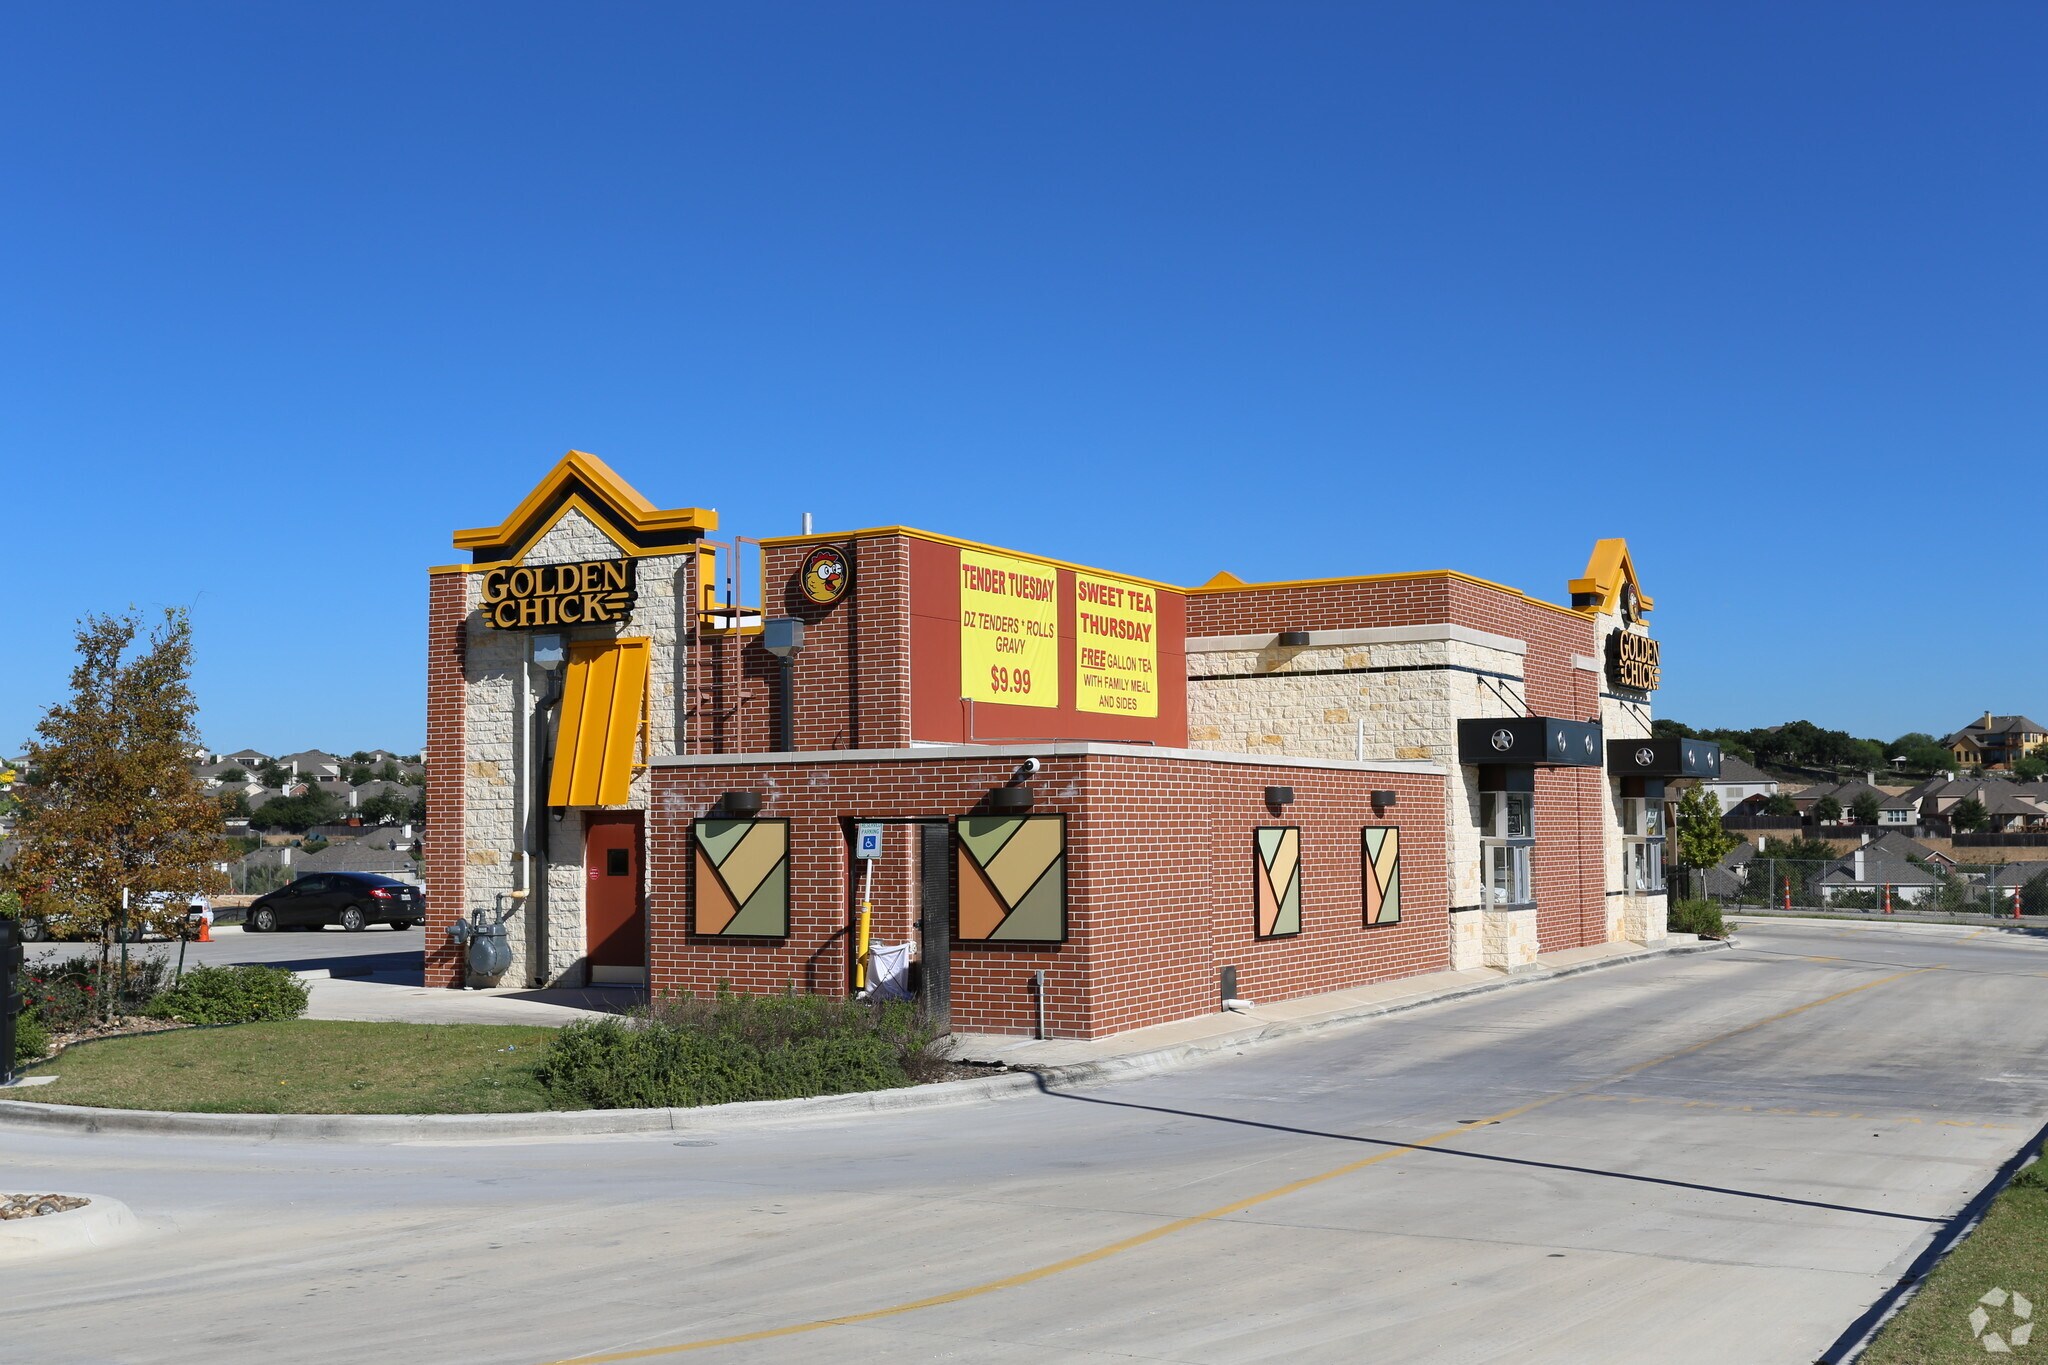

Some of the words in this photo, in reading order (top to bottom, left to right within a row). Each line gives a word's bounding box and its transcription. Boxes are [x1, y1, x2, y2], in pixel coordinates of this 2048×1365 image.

[481, 560, 628, 604] GOLDEN
[962, 564, 1006, 596] TENDER
[1008, 573, 1055, 603] TUESDAY
[1078, 580, 1124, 608] SWEET
[1127, 591, 1153, 613] TEA
[494, 592, 611, 628] CHICK
[964, 610, 976, 629] DZ
[978, 612, 1019, 634] TENDERS
[1026, 620, 1054, 639] ROLLS
[1080, 612, 1152, 643] THURSDAY
[995, 635, 1026, 655] GRAVY
[1081, 647, 1106, 670] FREE
[1107, 653, 1137, 672] GALLON
[1138, 657, 1152, 674] TEA
[1620, 630, 1660, 667] GOLDEN
[991, 664, 1031, 694] $9.99
[1083, 674, 1103, 688] WITH
[1104, 676, 1129, 692] FAMILY
[1131, 679, 1151, 694] MEAL
[1624, 659, 1657, 690] CHICK
[1098, 694, 1115, 708] AND
[1116, 696, 1137, 711] SIDES
